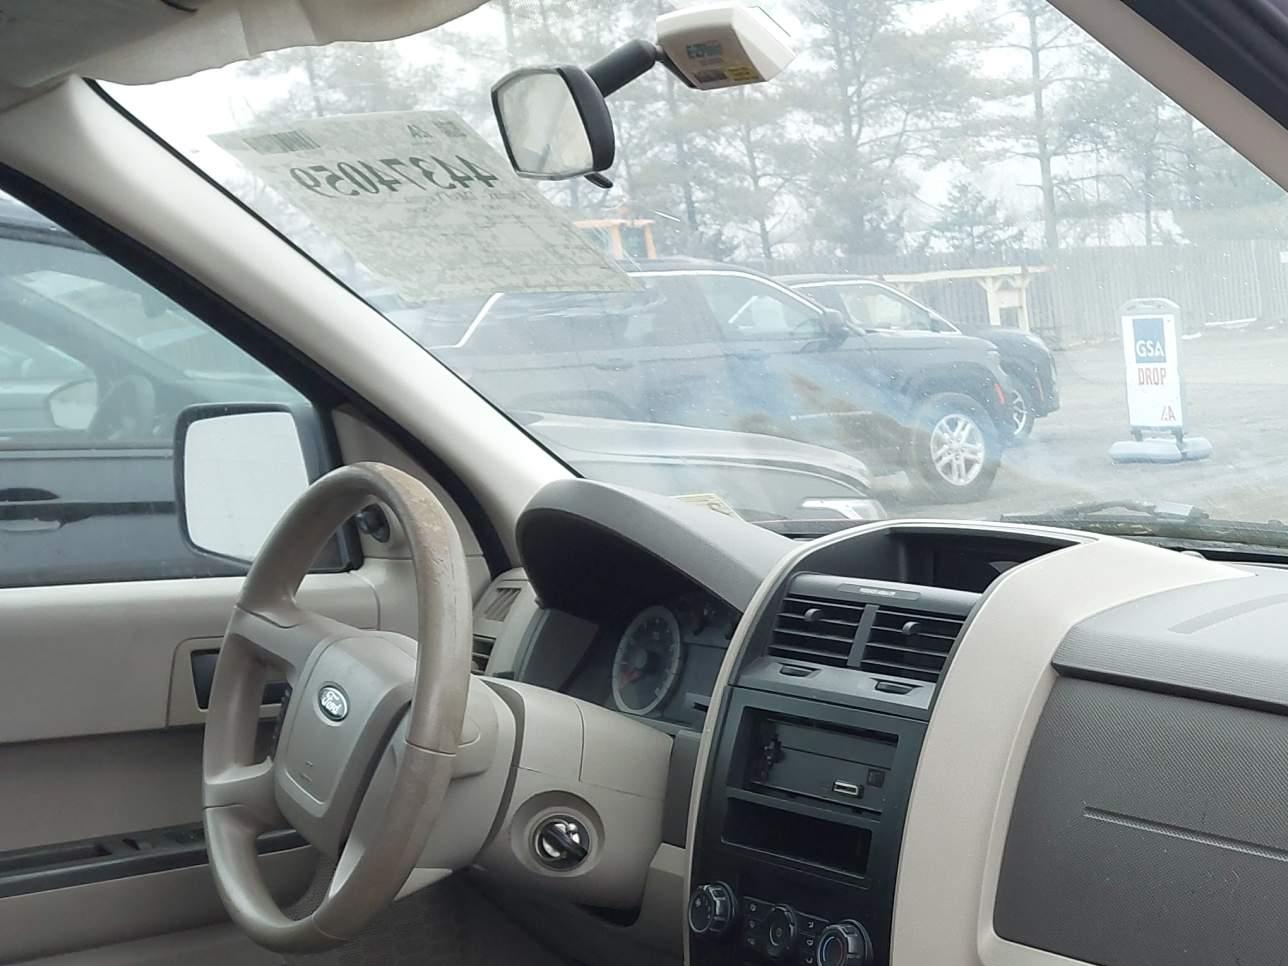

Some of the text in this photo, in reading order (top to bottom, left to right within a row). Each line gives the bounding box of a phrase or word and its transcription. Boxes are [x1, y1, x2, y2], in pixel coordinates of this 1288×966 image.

[1136, 339, 1165, 357] GSA
[1137, 367, 1167, 386] DROP
[320, 689, 344, 716] Ford
